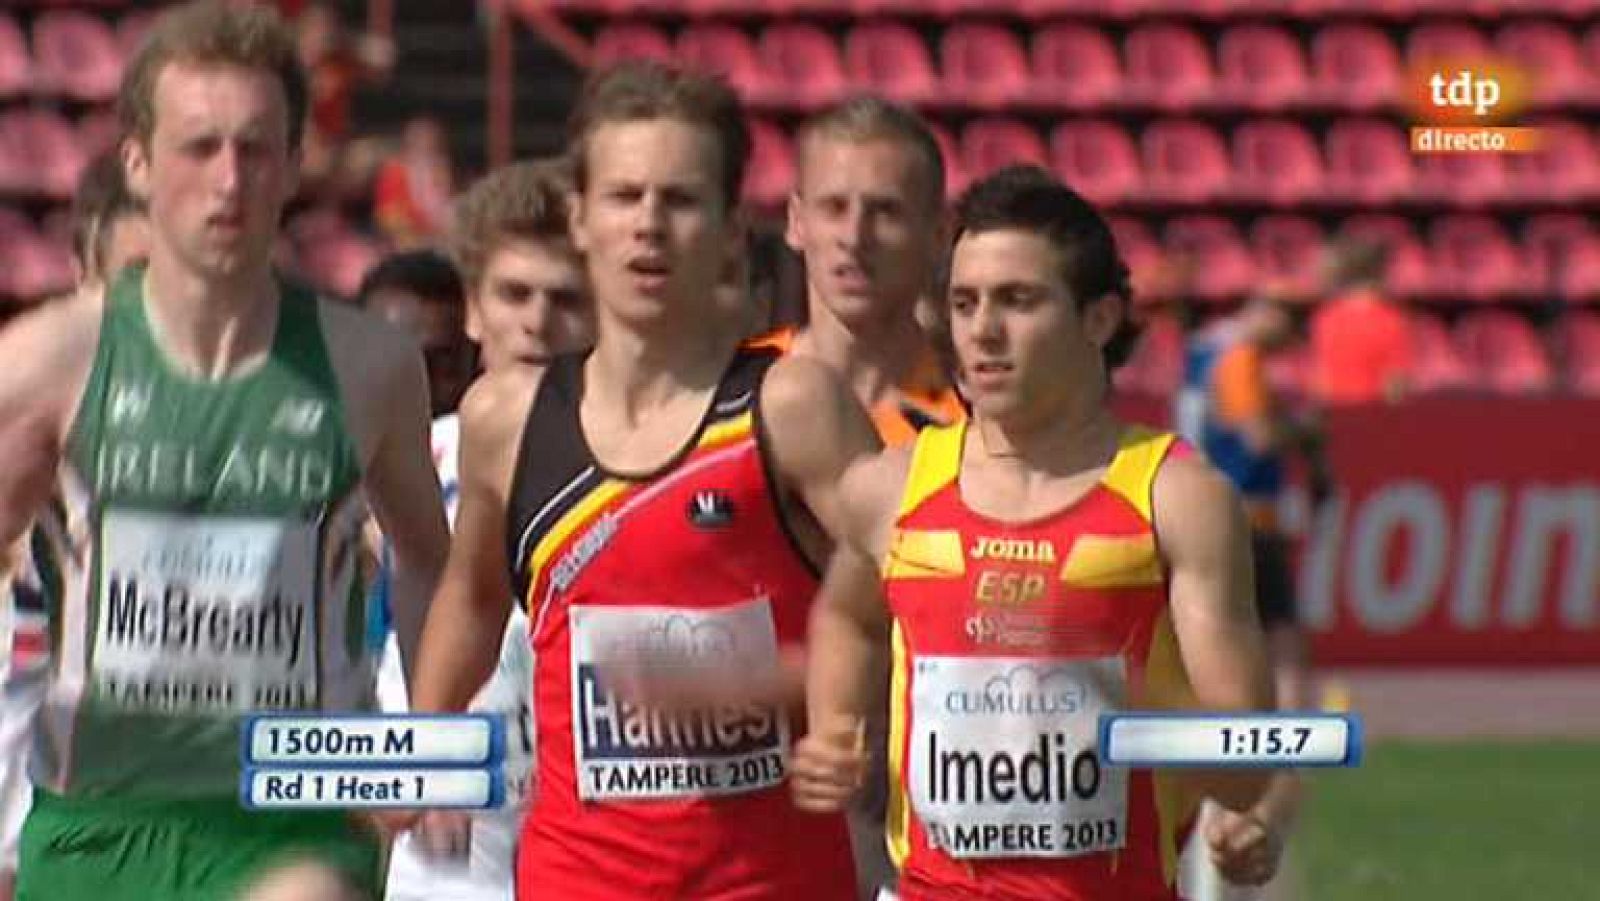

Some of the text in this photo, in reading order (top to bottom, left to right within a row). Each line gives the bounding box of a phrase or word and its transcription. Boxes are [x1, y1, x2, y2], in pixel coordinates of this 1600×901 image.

[97, 437, 331, 497] IRELAND
[976, 570, 1046, 602] ESP
[584, 678, 771, 748] Hannes
[947, 691, 1077, 714] CUMULUS
[589, 754, 785, 791] TAMPERE 2013
[928, 731, 1100, 804] Imedio
[1062, 819, 1119, 850] 2013
